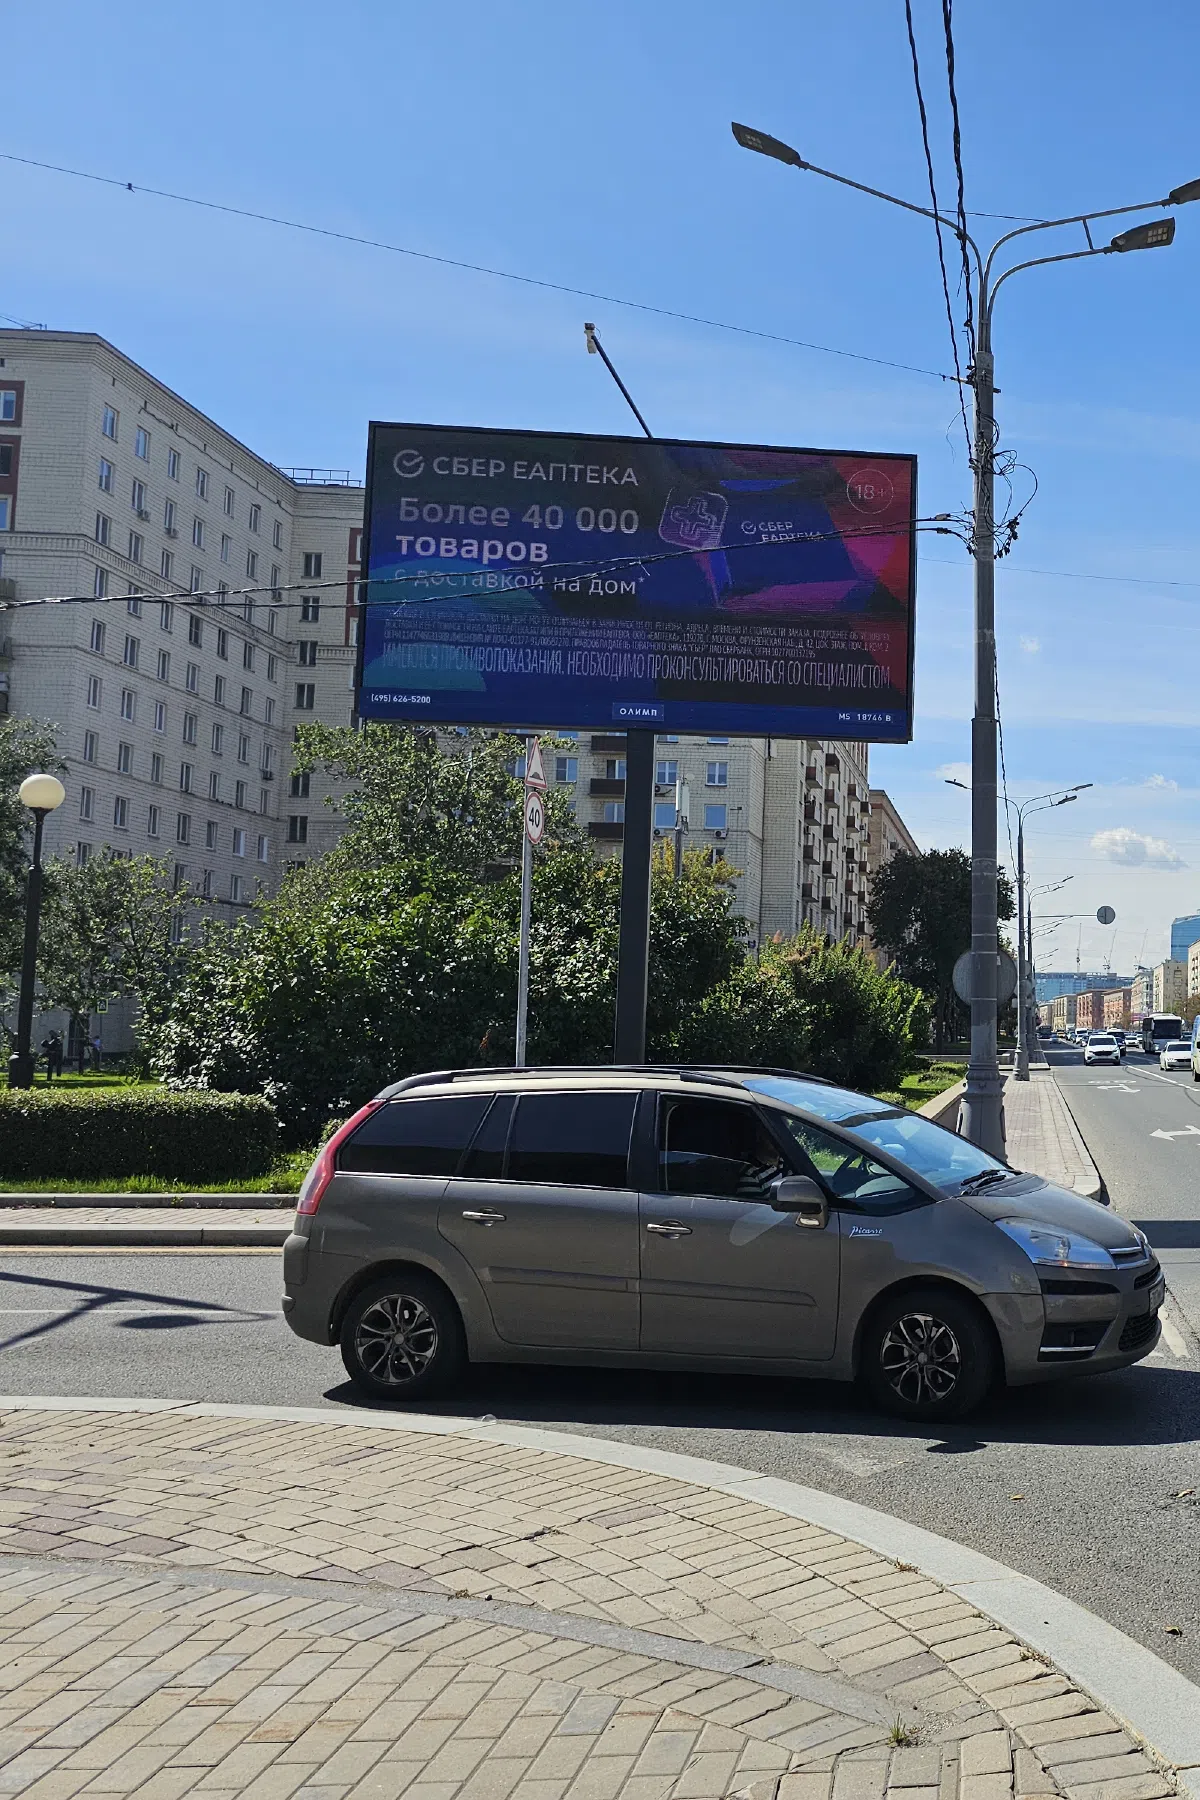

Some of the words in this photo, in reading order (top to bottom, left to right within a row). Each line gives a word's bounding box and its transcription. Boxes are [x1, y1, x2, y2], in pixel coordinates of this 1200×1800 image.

[432, 456, 505, 477] СБЕР
[513, 460, 639, 486] ЕАПТЕКА
[855, 484, 887, 500] 18+
[400, 497, 510, 527] Более
[521, 504, 564, 530] 40
[576, 506, 640, 534] 000
[758, 521, 793, 532] СБЕР
[396, 534, 549, 564] товаров
[414, 570, 544, 590] доставкой
[554, 578, 580, 593] на
[567, 649, 644, 682] НЕОБХОДИМО
[647, 653, 784, 685] ПРОКОНСУЛЬТИРОВАТЬСЯ
[787, 659, 801, 685] СО
[803, 660, 890, 692] СПЕЦИАЛИСТОМ
[372, 694, 390, 702] (495)
[392, 695, 430, 704] 626-5200
[620, 708, 657, 716] ОЛИМП
[838, 712, 850, 720] MS
[528, 806, 540, 828] 40
